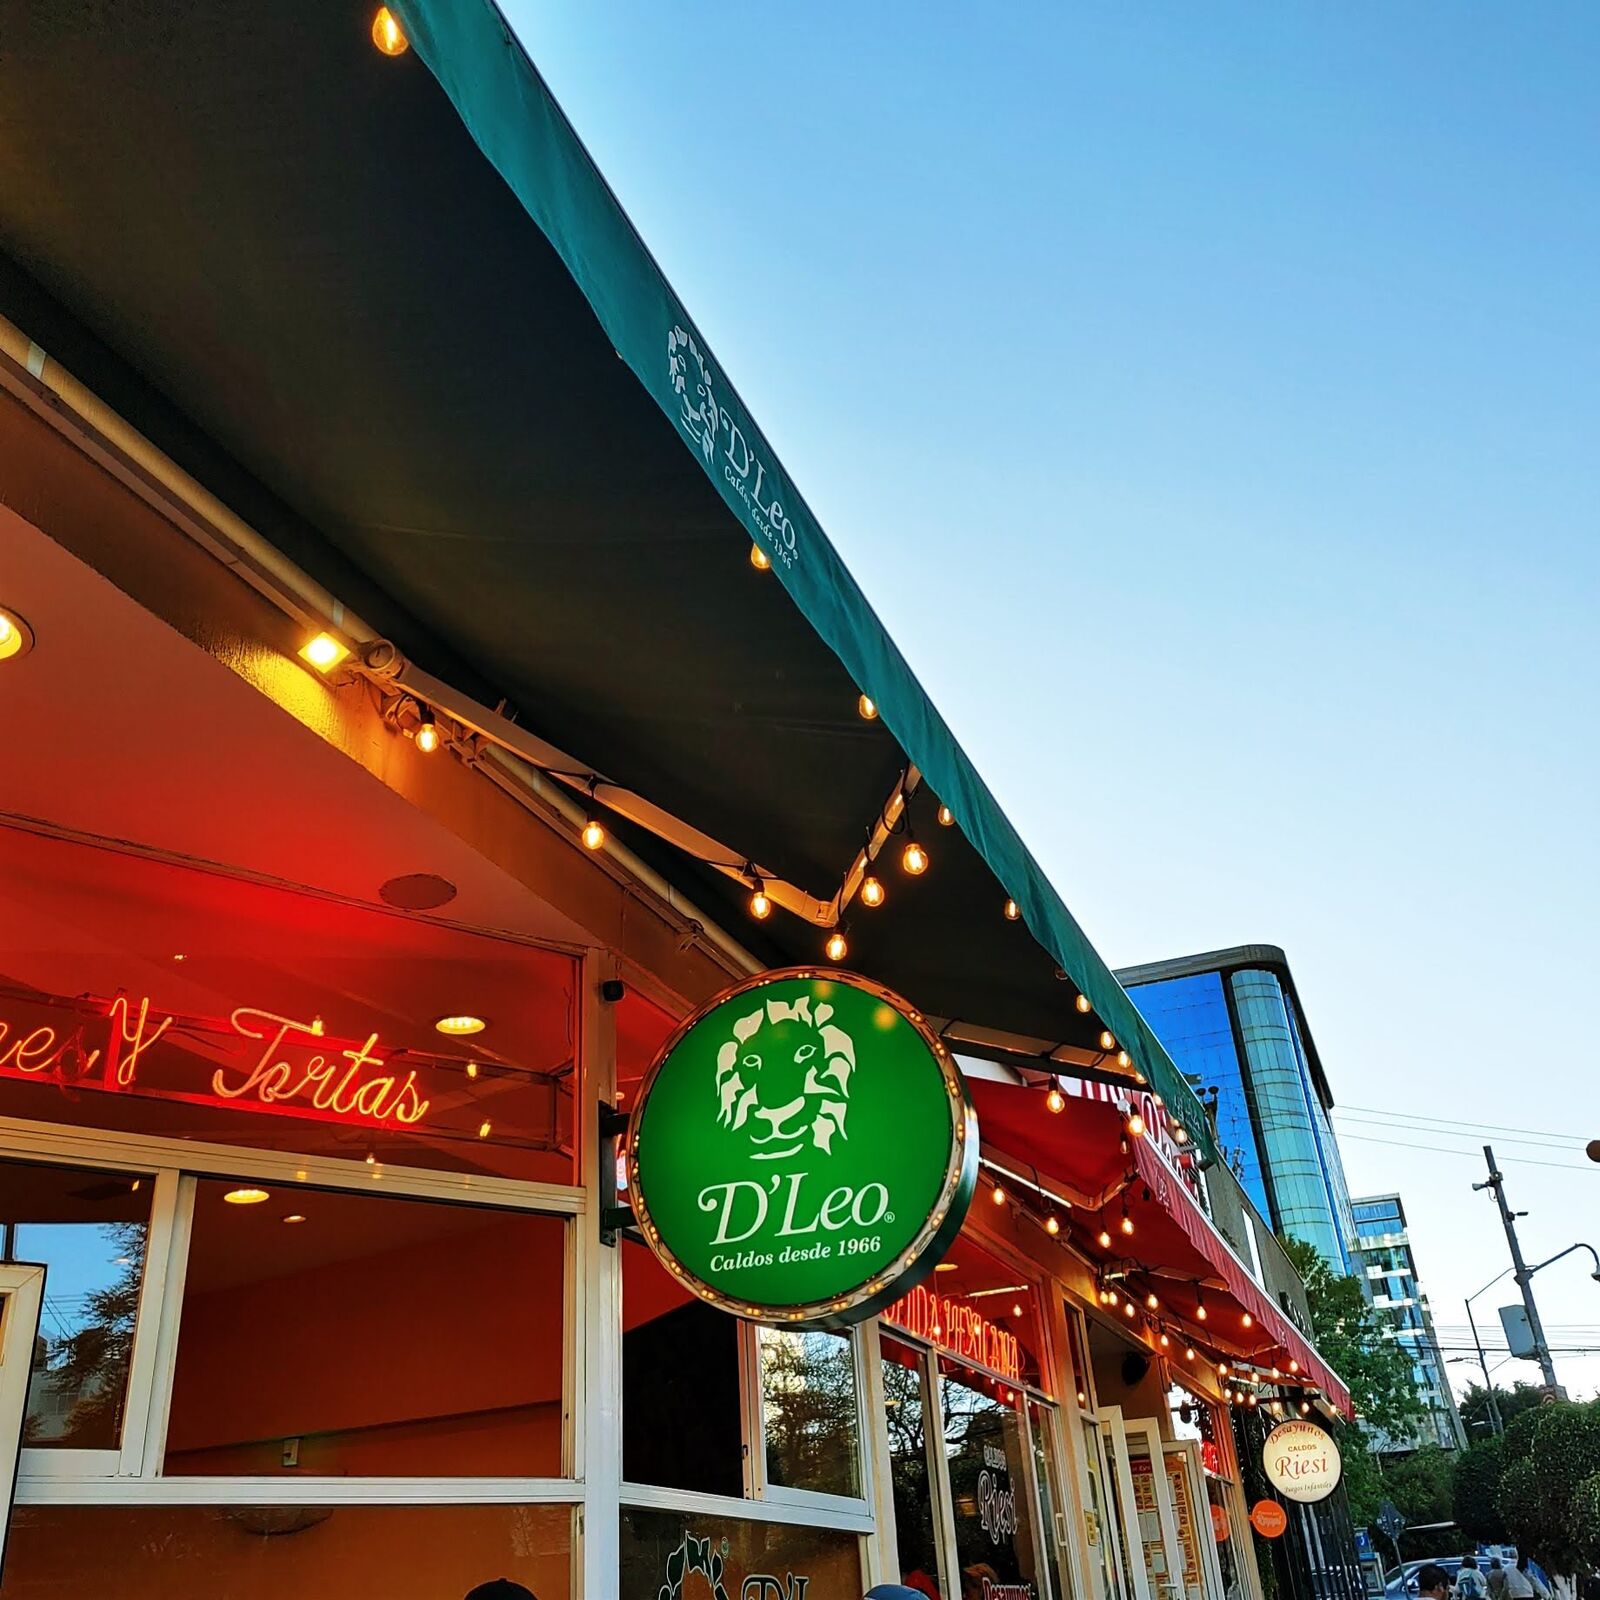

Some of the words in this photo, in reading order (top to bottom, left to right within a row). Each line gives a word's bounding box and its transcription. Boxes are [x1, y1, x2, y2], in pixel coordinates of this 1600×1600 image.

[774, 537, 793, 570] 1966
[212, 1007, 430, 1124] Tortas
[709, 1247, 774, 1272] Caldos
[778, 1241, 832, 1264] desde
[837, 1235, 882, 1257] 1966
[1269, 1423, 1326, 1444] Desayunos
[1287, 1444, 1317, 1453] CALDOS
[1274, 1451, 1329, 1480] Riesi
